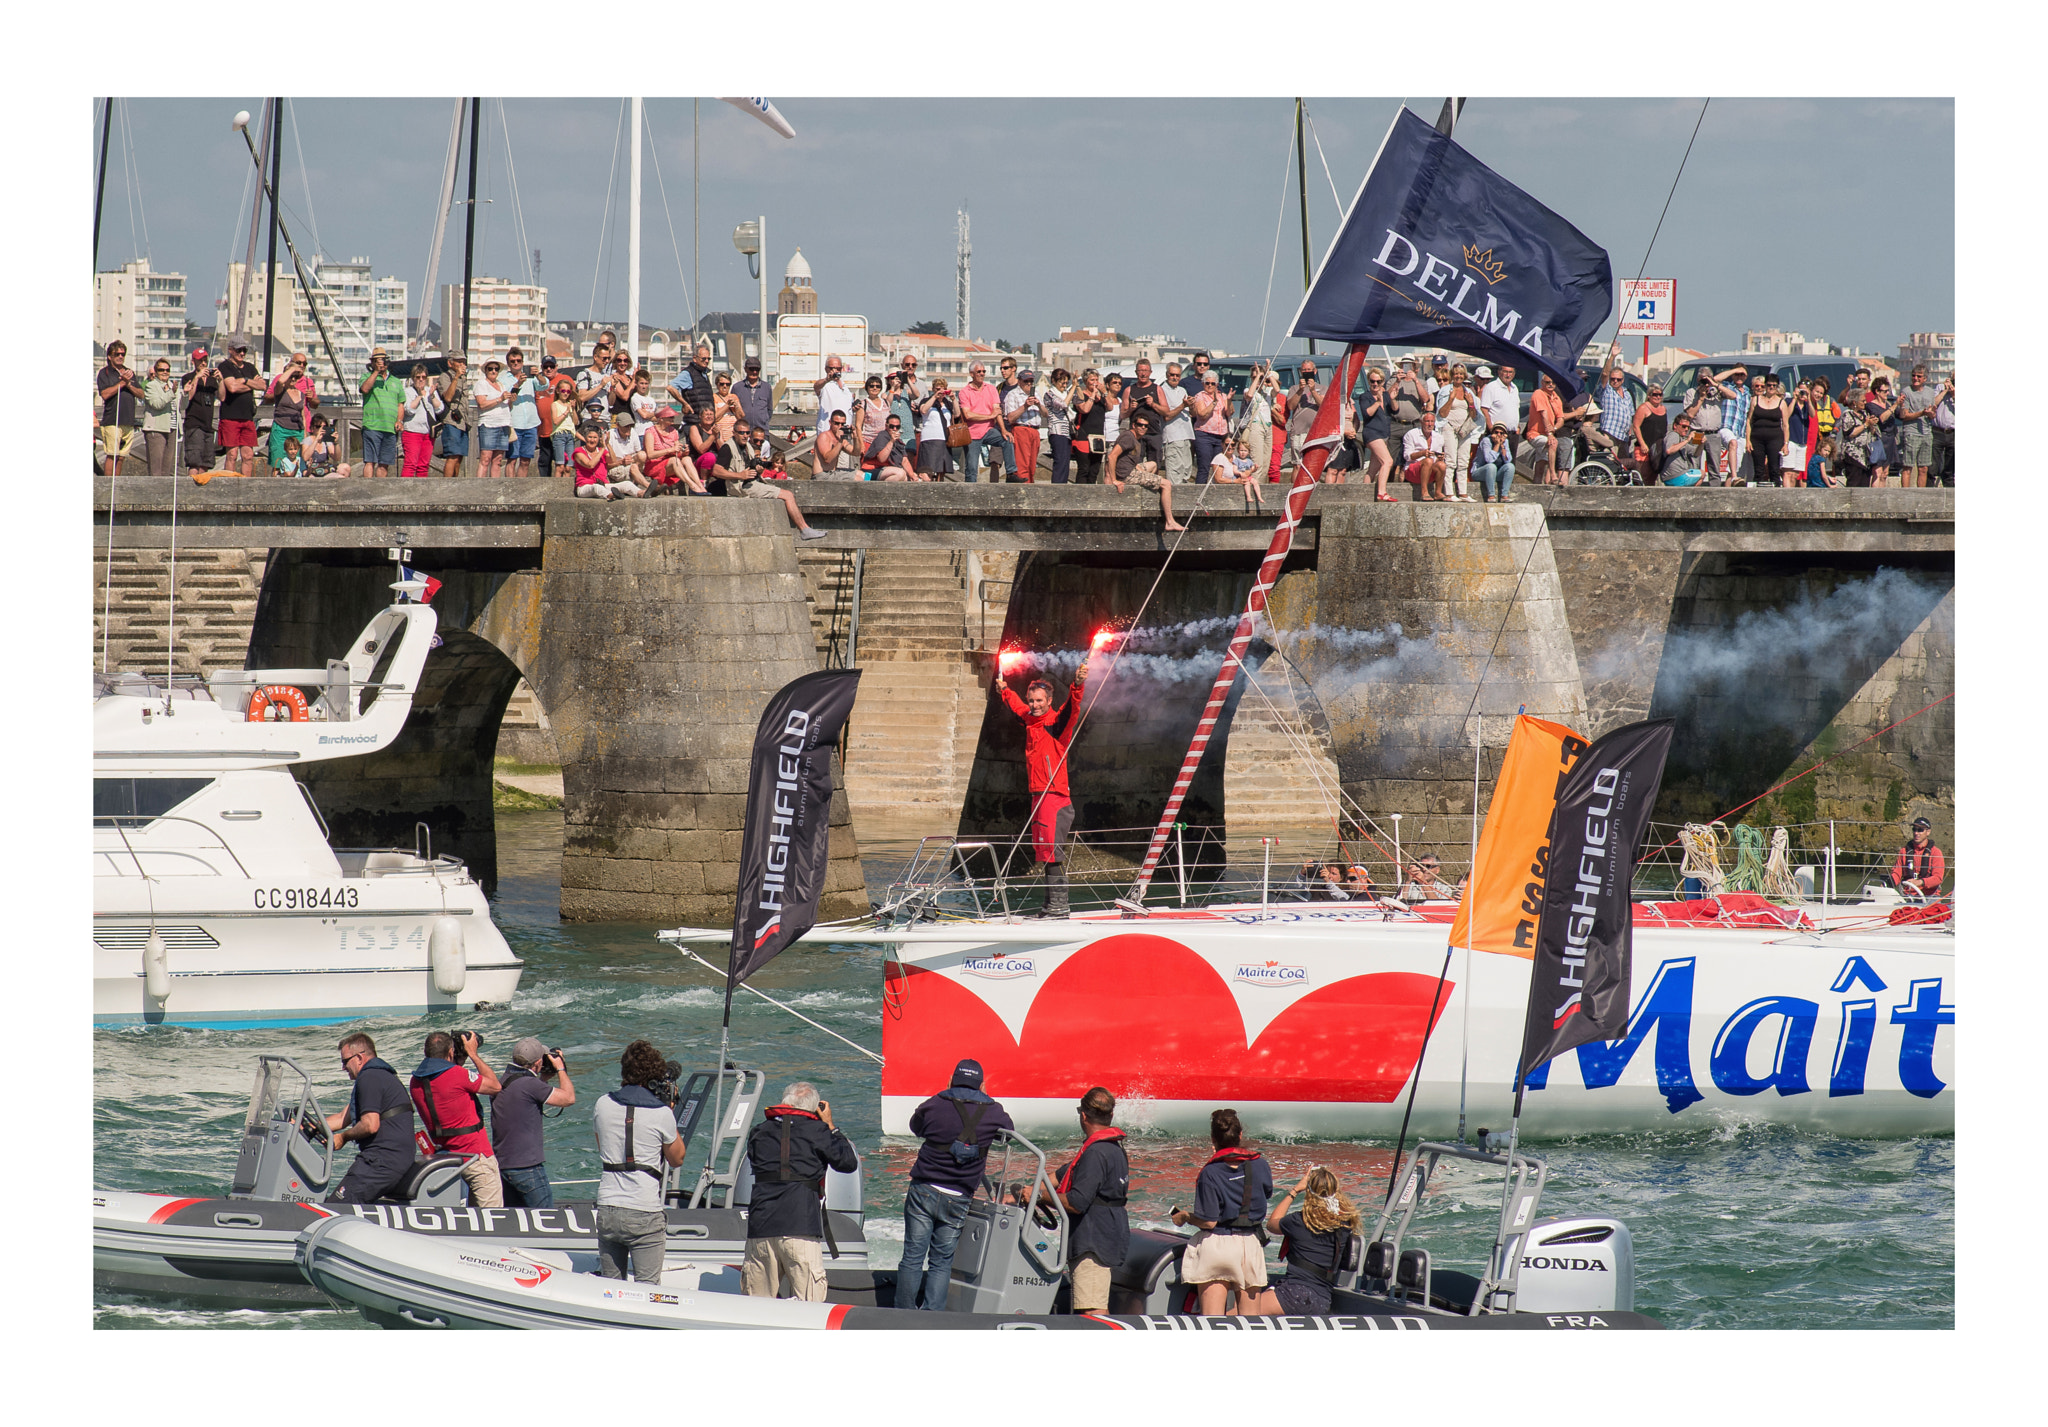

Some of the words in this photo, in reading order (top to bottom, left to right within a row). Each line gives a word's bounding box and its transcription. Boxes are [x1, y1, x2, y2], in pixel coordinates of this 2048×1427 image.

[1372, 229, 1543, 356] DELMA
[1625, 281, 1647, 289] VITESSE
[318, 734, 378, 745] Birchwood
[797, 756, 812, 827] aluminium
[807, 715, 822, 750] boats
[759, 709, 810, 911] HIGHFIELD
[1512, 735, 1588, 949] PSSE
[1606, 818, 1621, 897] aluminium
[1617, 770, 1632, 811] boats
[1559, 767, 1619, 988] HIGHFIELD
[254, 887, 359, 909] CC918443
[335, 925, 426, 950] TS34
[964, 959, 1004, 970] Maître
[1237, 967, 1277, 978] Maître
[352, 1204, 598, 1233] HIGHFIEL
[1513, 1256, 1609, 1272] HONDA
[1013, 1276, 1023, 1285] BR
[1546, 1315, 1609, 1327] FRA
